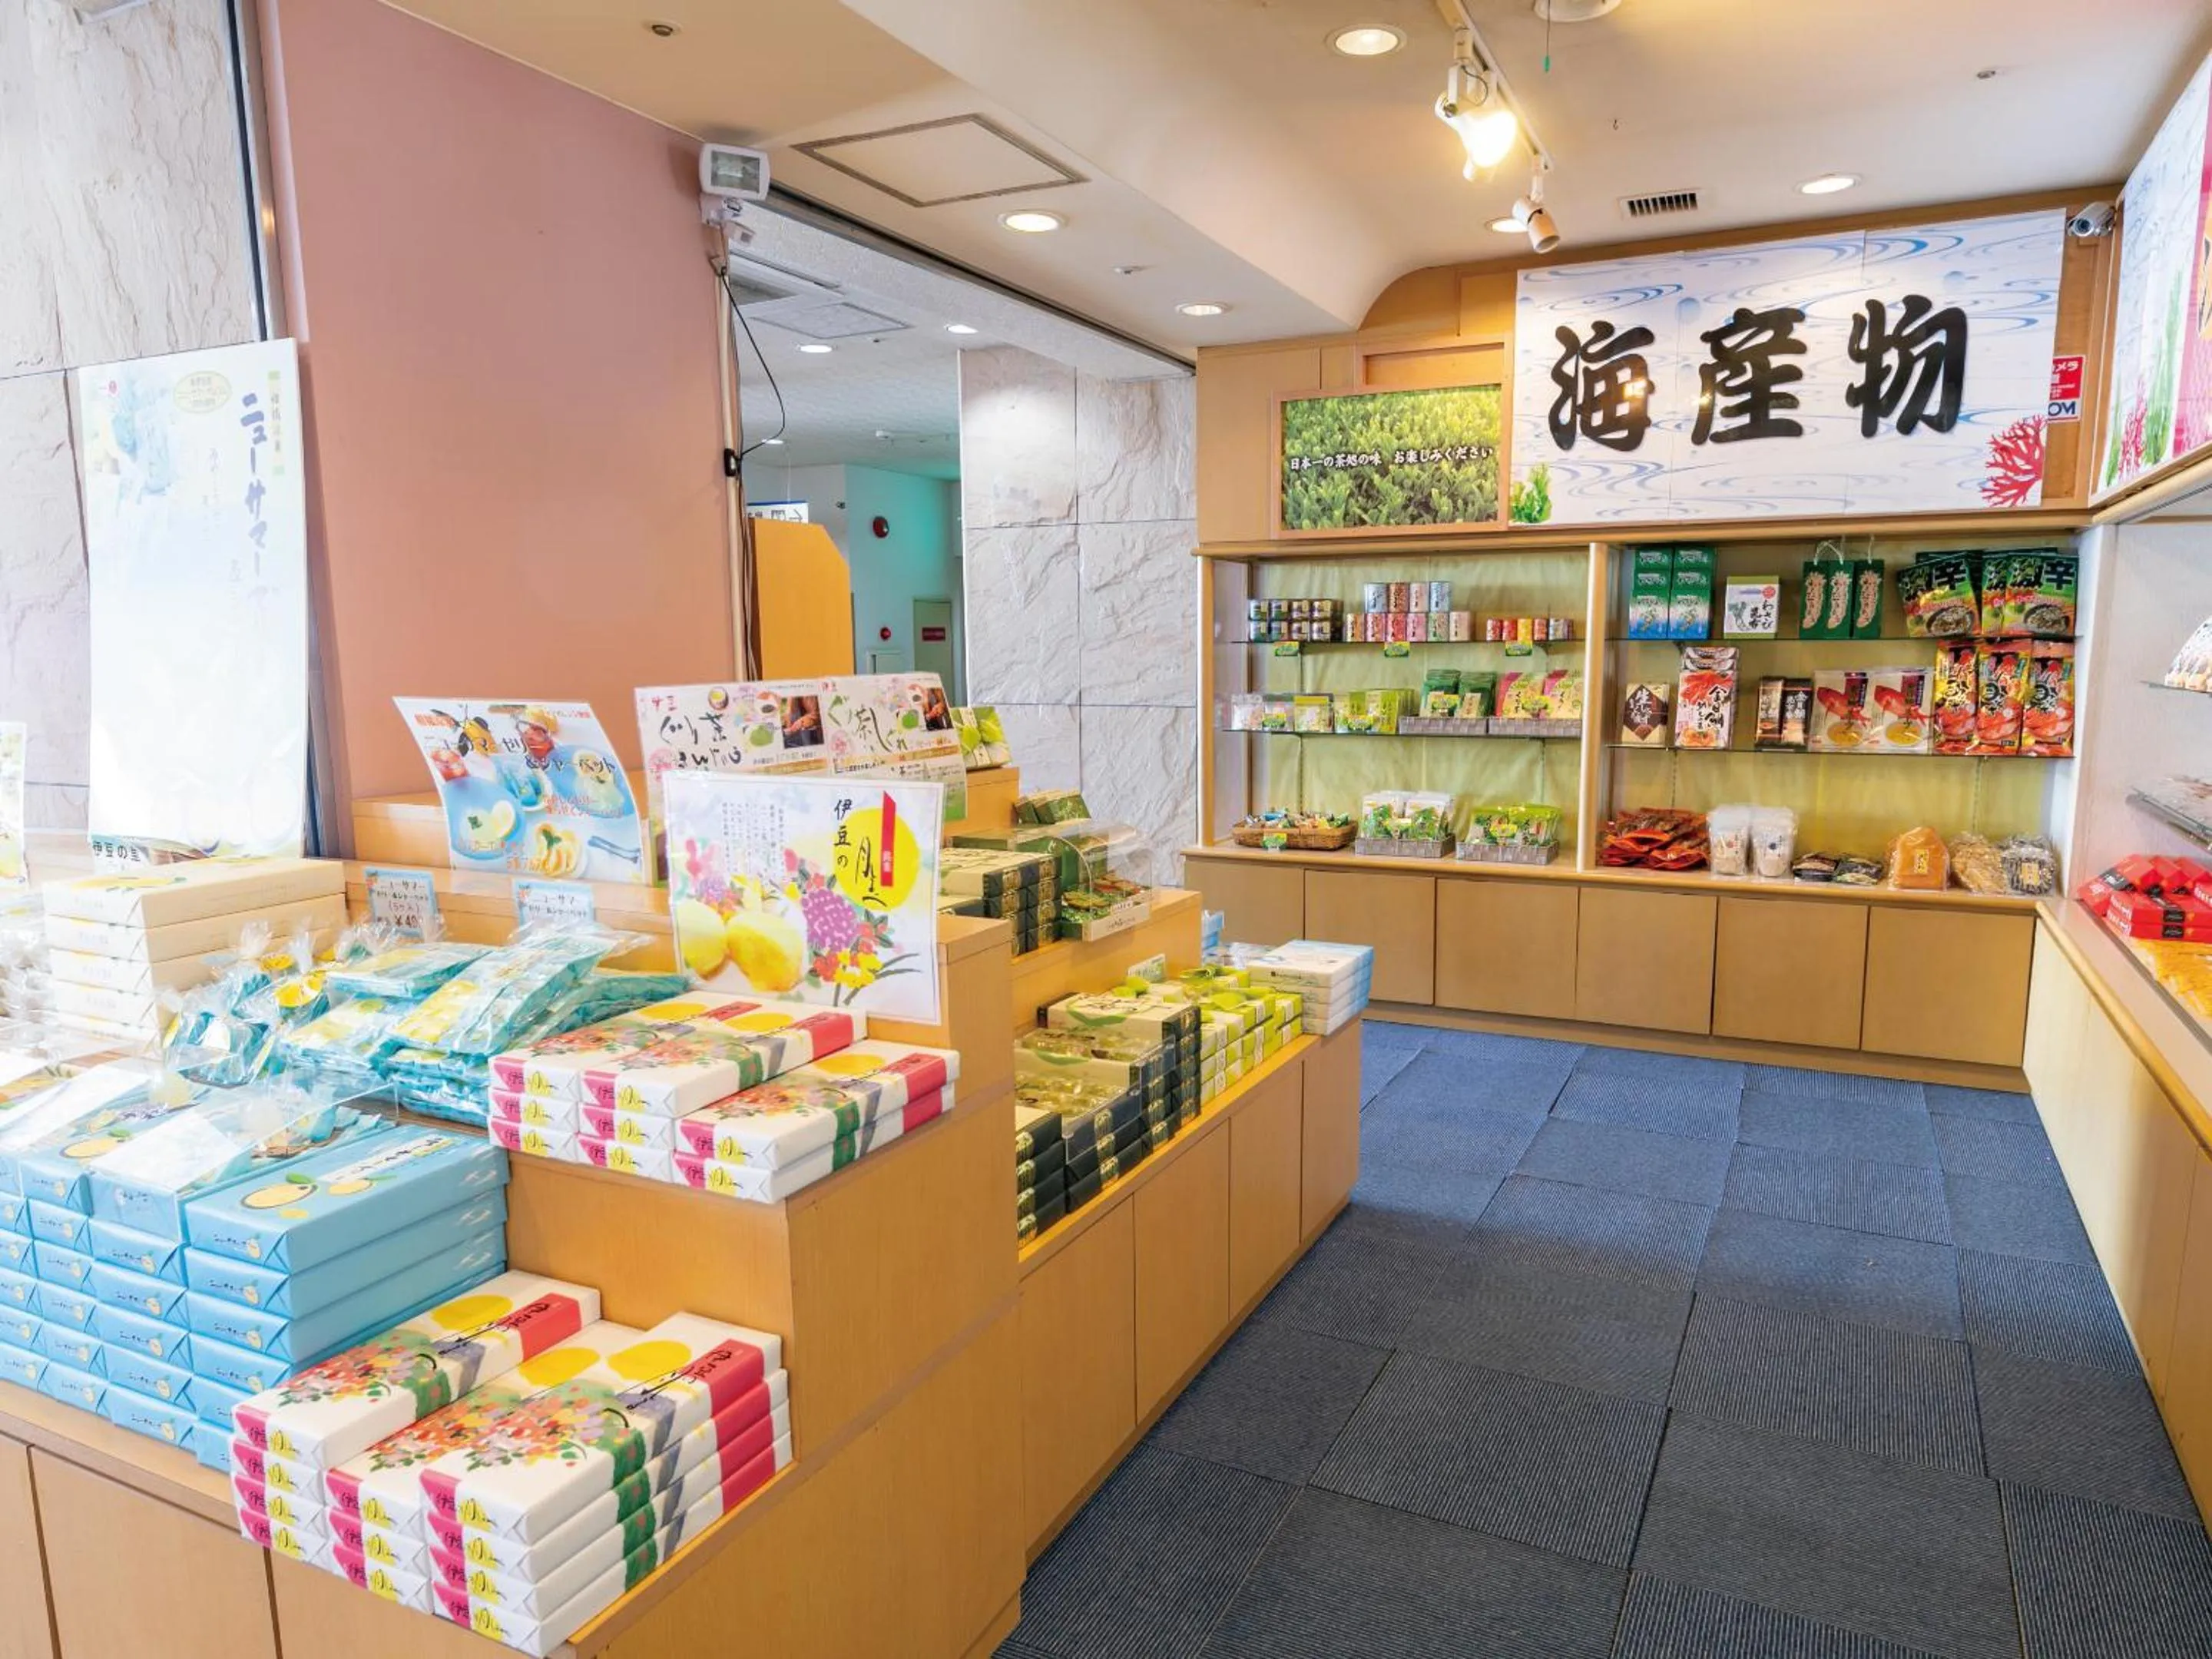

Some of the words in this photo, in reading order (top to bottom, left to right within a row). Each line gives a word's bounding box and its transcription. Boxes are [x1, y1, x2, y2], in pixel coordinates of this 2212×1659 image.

[1548, 294, 1967, 452] 海産物
[1290, 453, 1382, 470] 日本一の茶処の味
[1394, 446, 1493, 464] お楽しみください
[834, 798, 853, 869] 伊豆の
